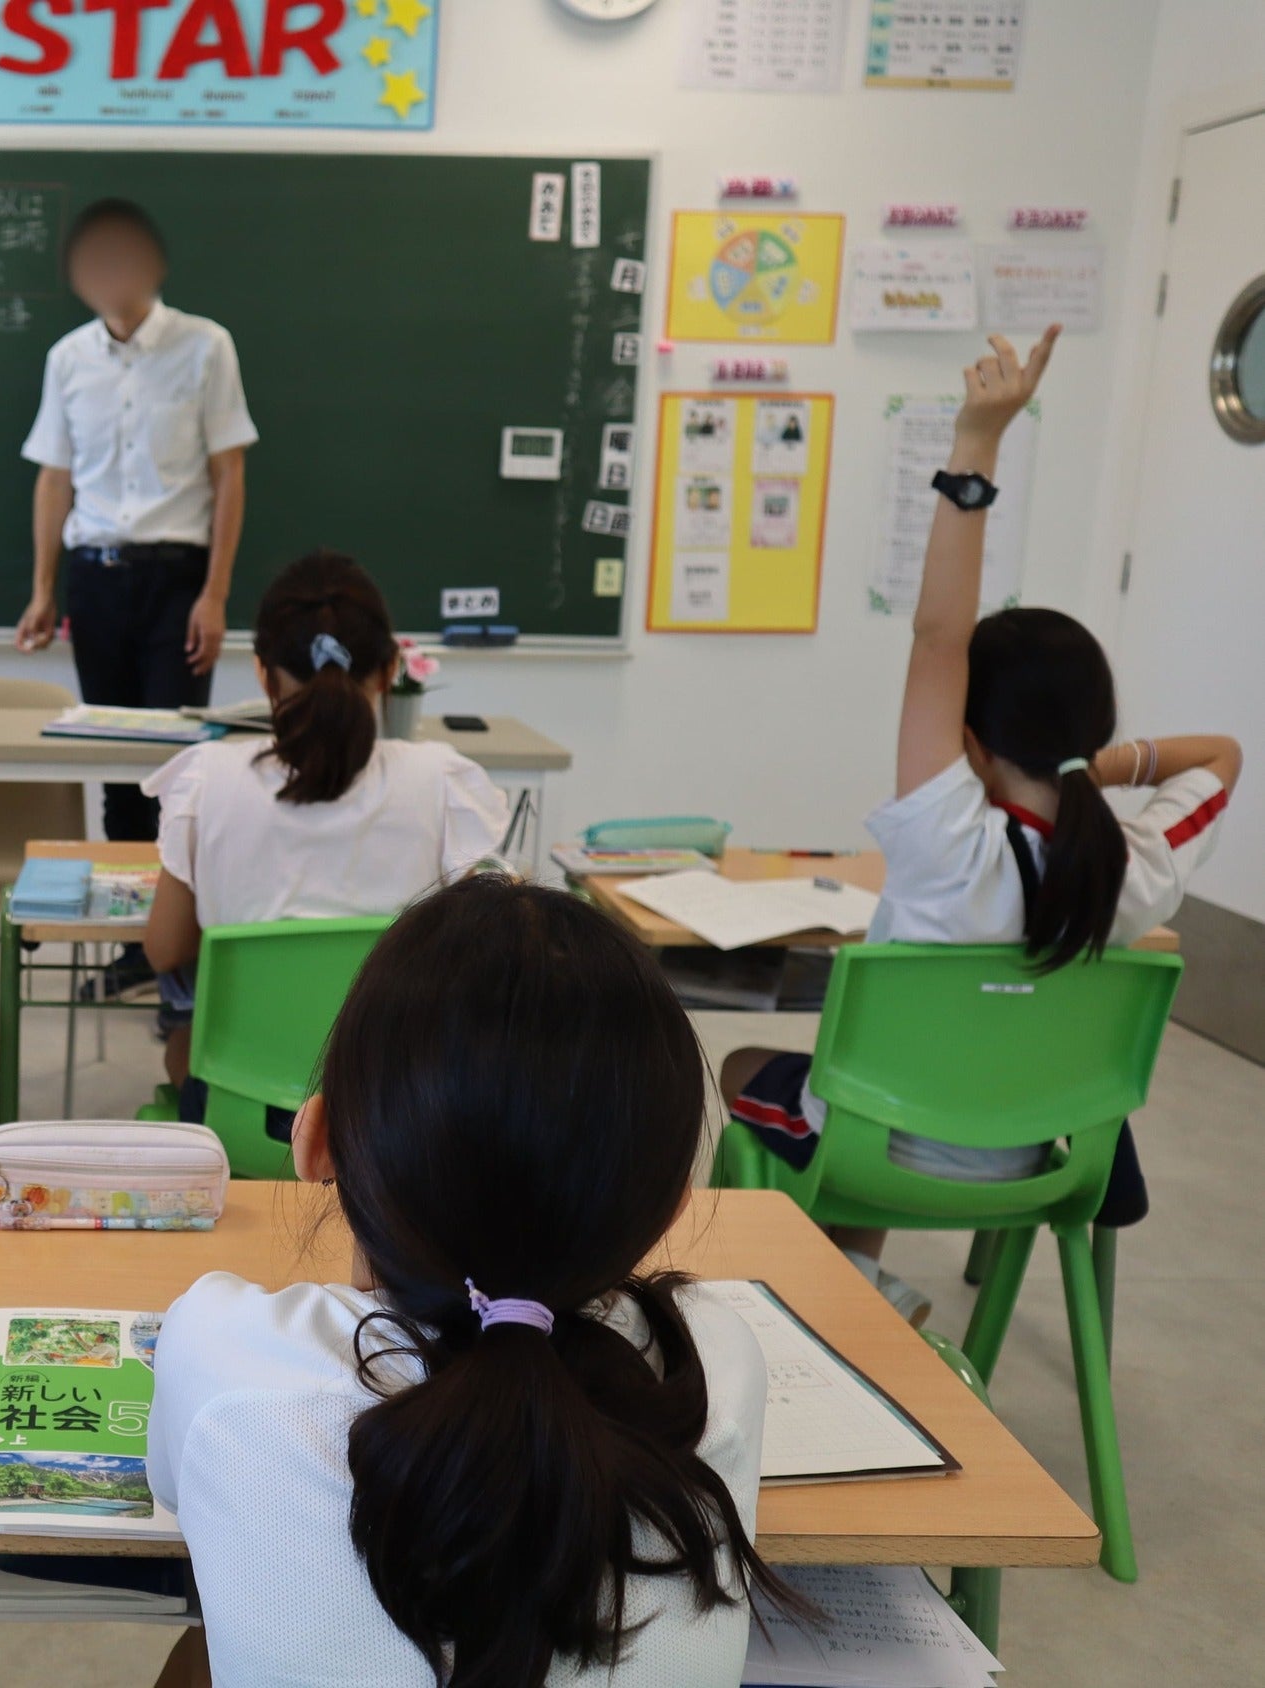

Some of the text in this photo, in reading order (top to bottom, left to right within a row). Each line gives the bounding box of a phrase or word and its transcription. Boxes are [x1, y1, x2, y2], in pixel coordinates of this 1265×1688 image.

[10, 1374, 40, 1383] 新編
[0, 1384, 102, 1402] 新しい
[108, 1400, 151, 1437] 5
[9, 1434, 28, 1445] 上
